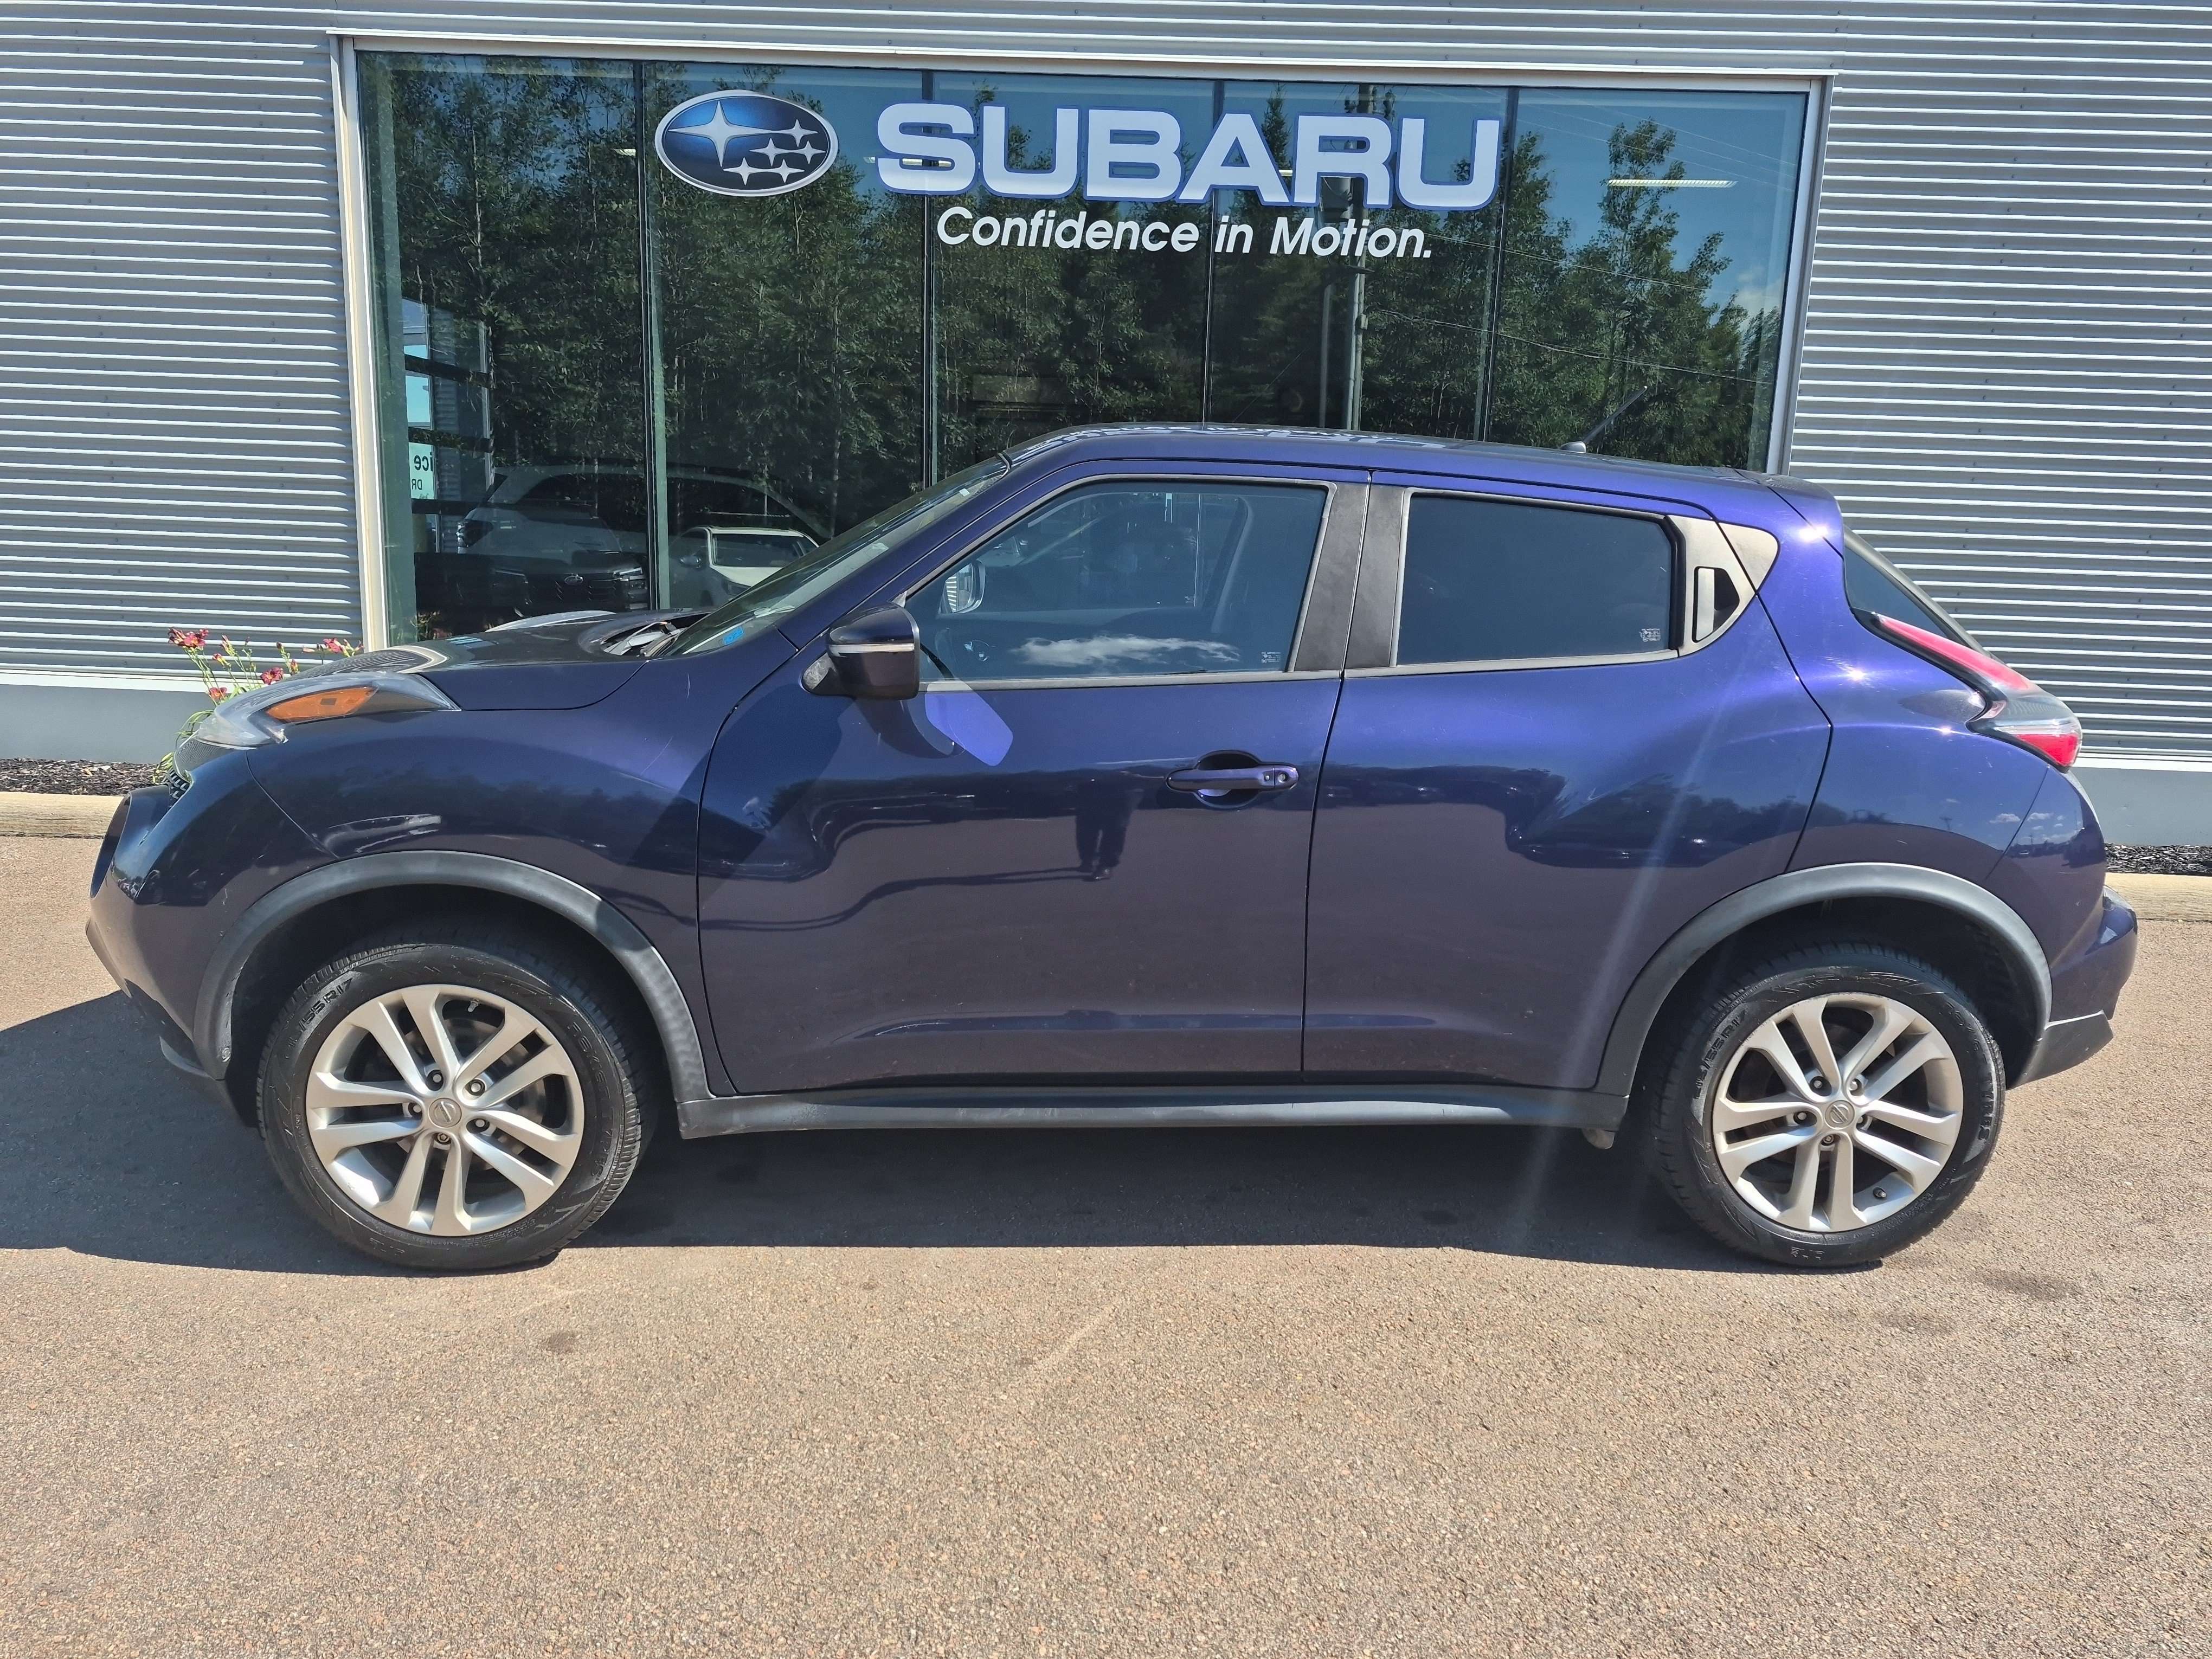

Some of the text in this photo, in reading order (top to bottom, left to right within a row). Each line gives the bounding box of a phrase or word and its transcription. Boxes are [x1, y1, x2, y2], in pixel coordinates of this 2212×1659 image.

[876, 102, 1501, 208] SUBARU
[937, 206, 1432, 259] Confidence in Motion.
